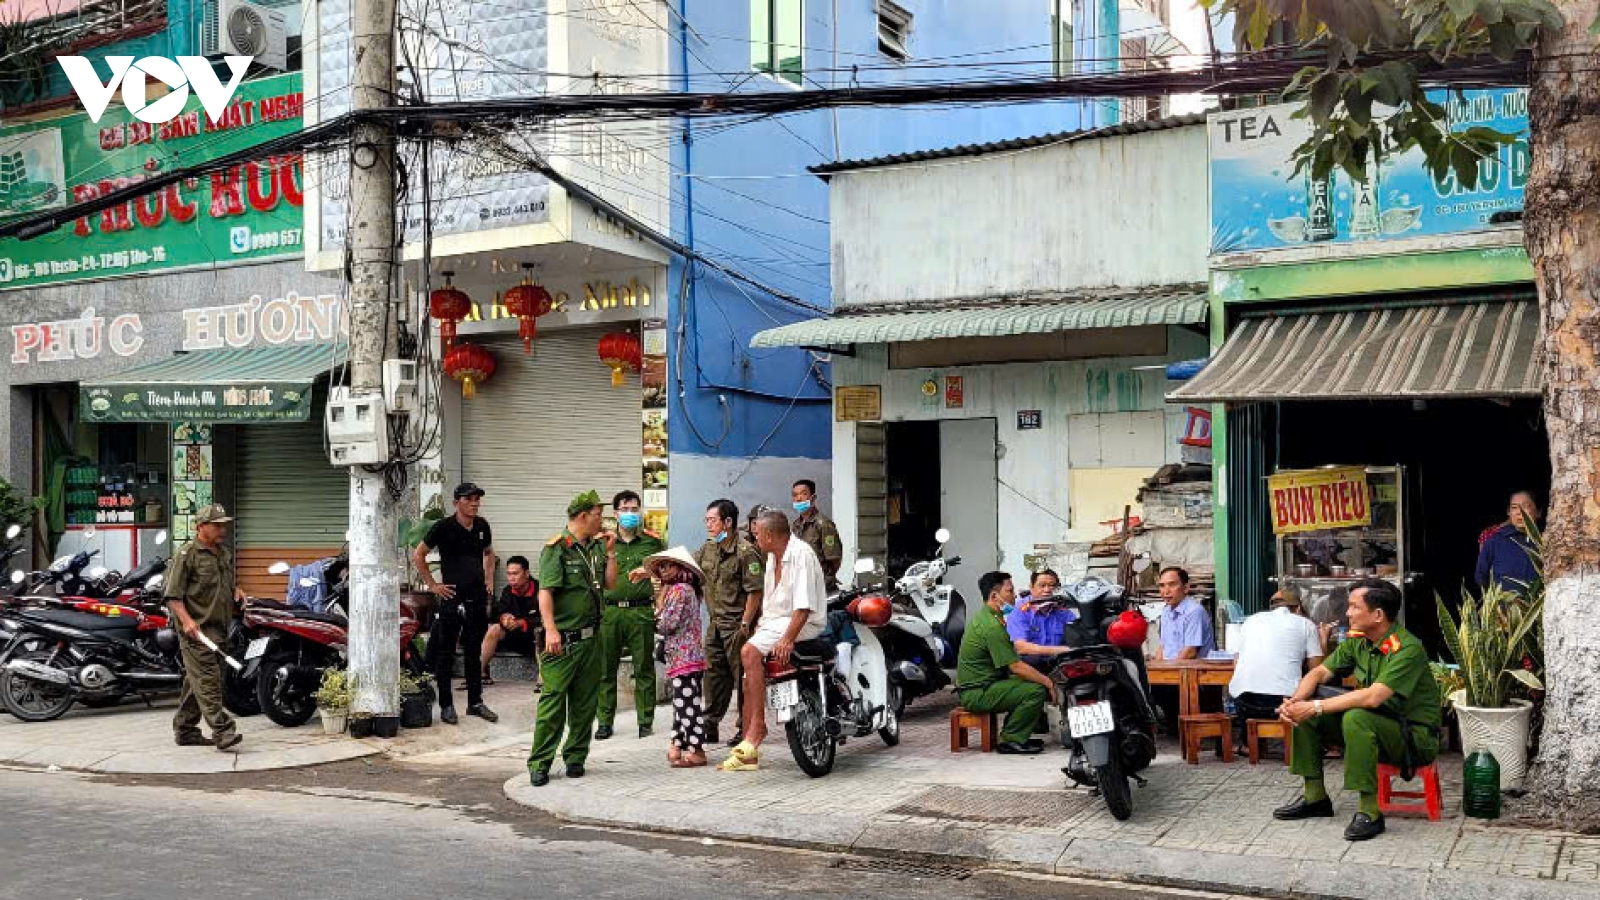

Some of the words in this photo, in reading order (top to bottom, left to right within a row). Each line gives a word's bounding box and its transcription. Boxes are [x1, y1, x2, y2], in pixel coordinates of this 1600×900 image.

[1217, 115, 1281, 143] TEA
[11, 306, 144, 364] PHÚC
[182, 290, 349, 350] HƯƠN
[1273, 479, 1316, 527] BÚN
